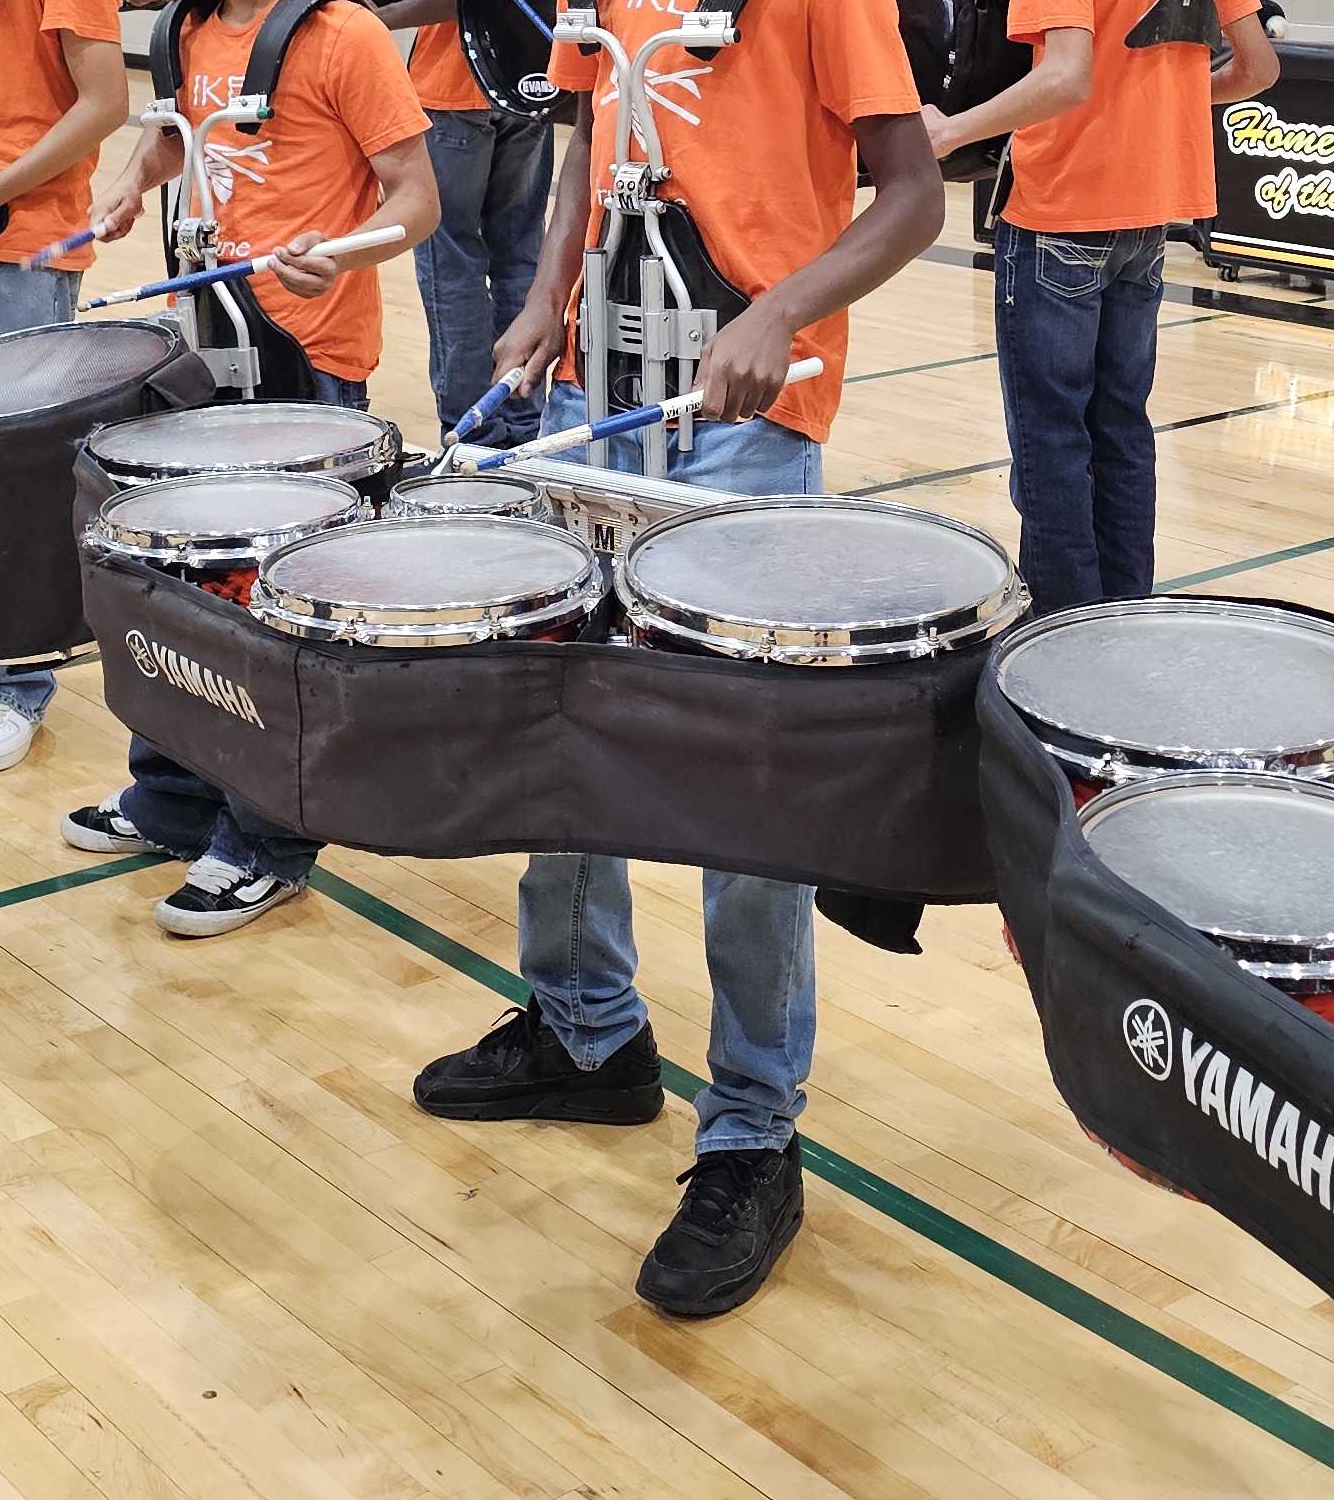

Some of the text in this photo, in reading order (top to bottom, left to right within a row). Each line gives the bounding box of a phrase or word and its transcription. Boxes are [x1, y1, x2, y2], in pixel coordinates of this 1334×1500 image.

[1259, 172, 1293, 214] of
[594, 523, 615, 551] M
[151, 641, 266, 730] YAMAHA
